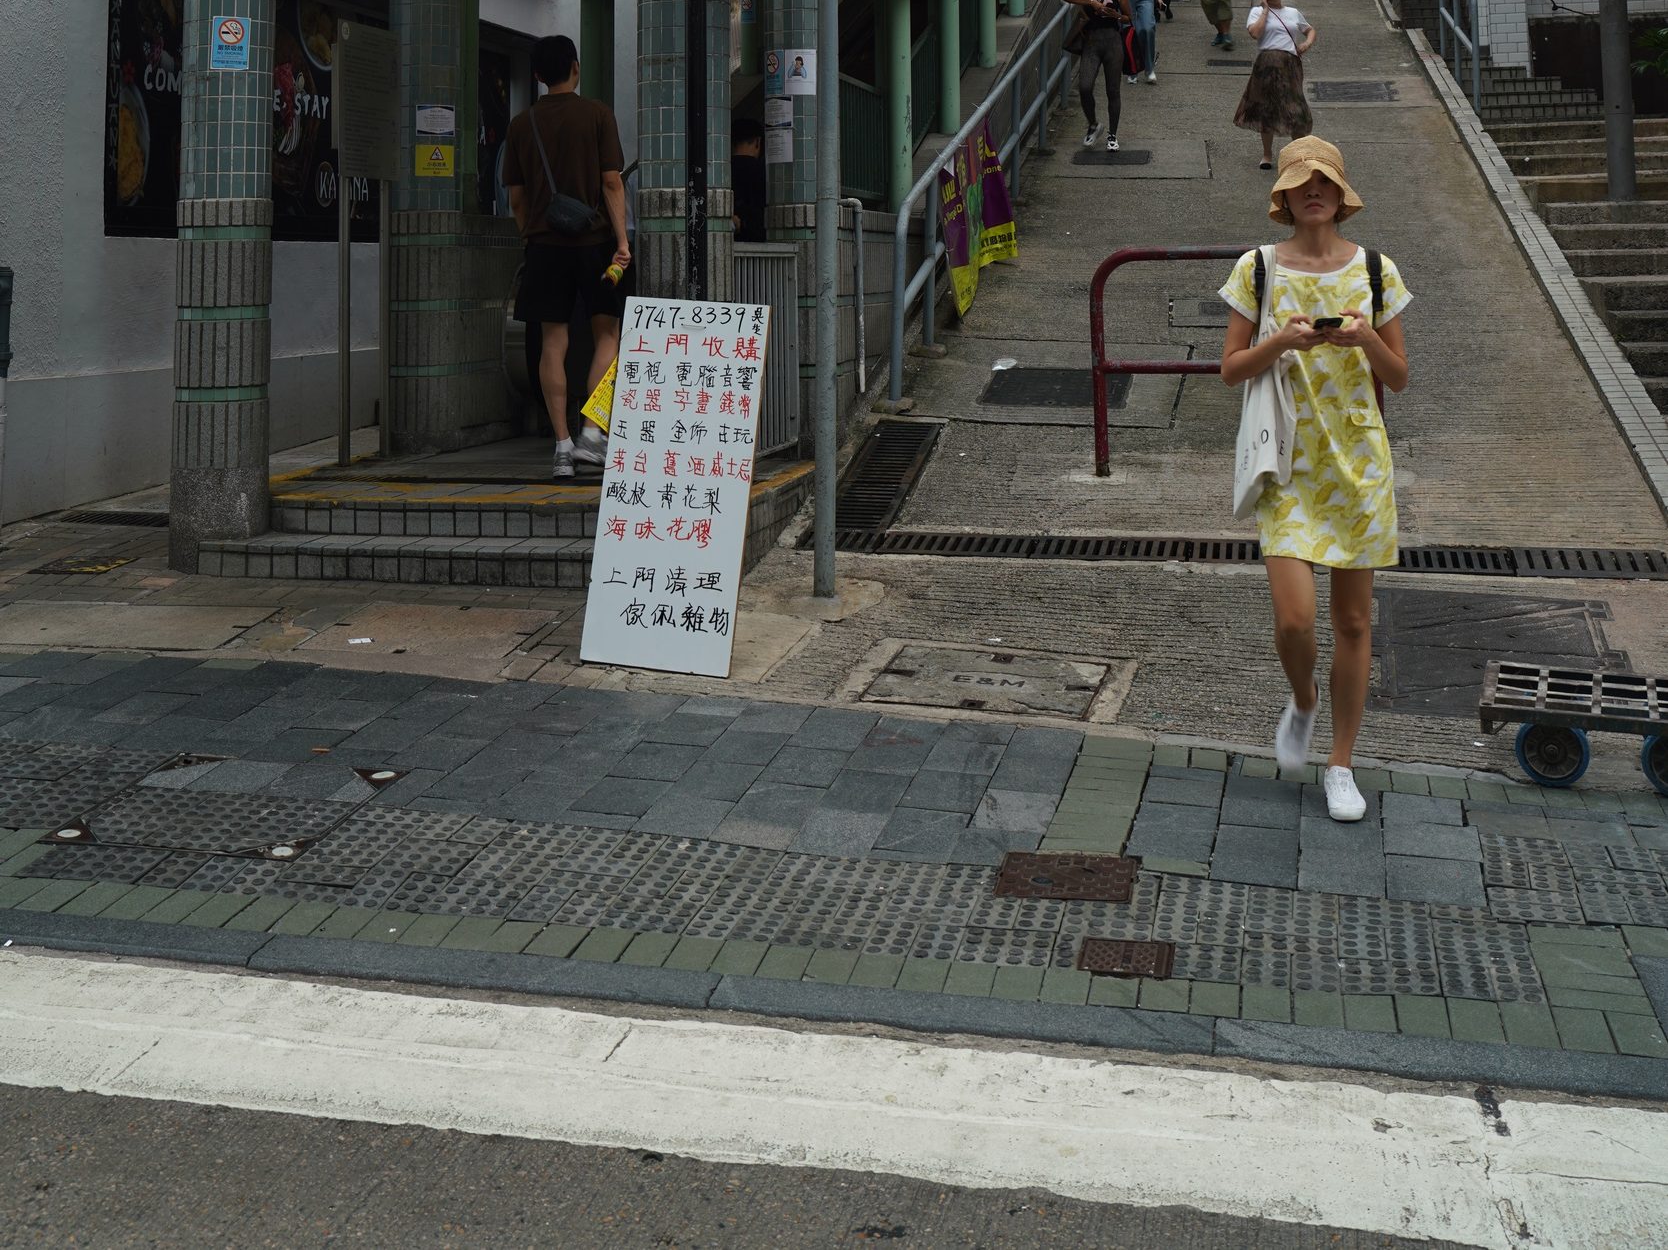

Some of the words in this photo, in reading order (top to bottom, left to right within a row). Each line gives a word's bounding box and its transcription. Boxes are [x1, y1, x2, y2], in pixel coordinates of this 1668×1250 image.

[294, 92, 330, 120] STAY
[633, 304, 746, 334] 9747-8339
[952, 674, 1026, 688] E&M
